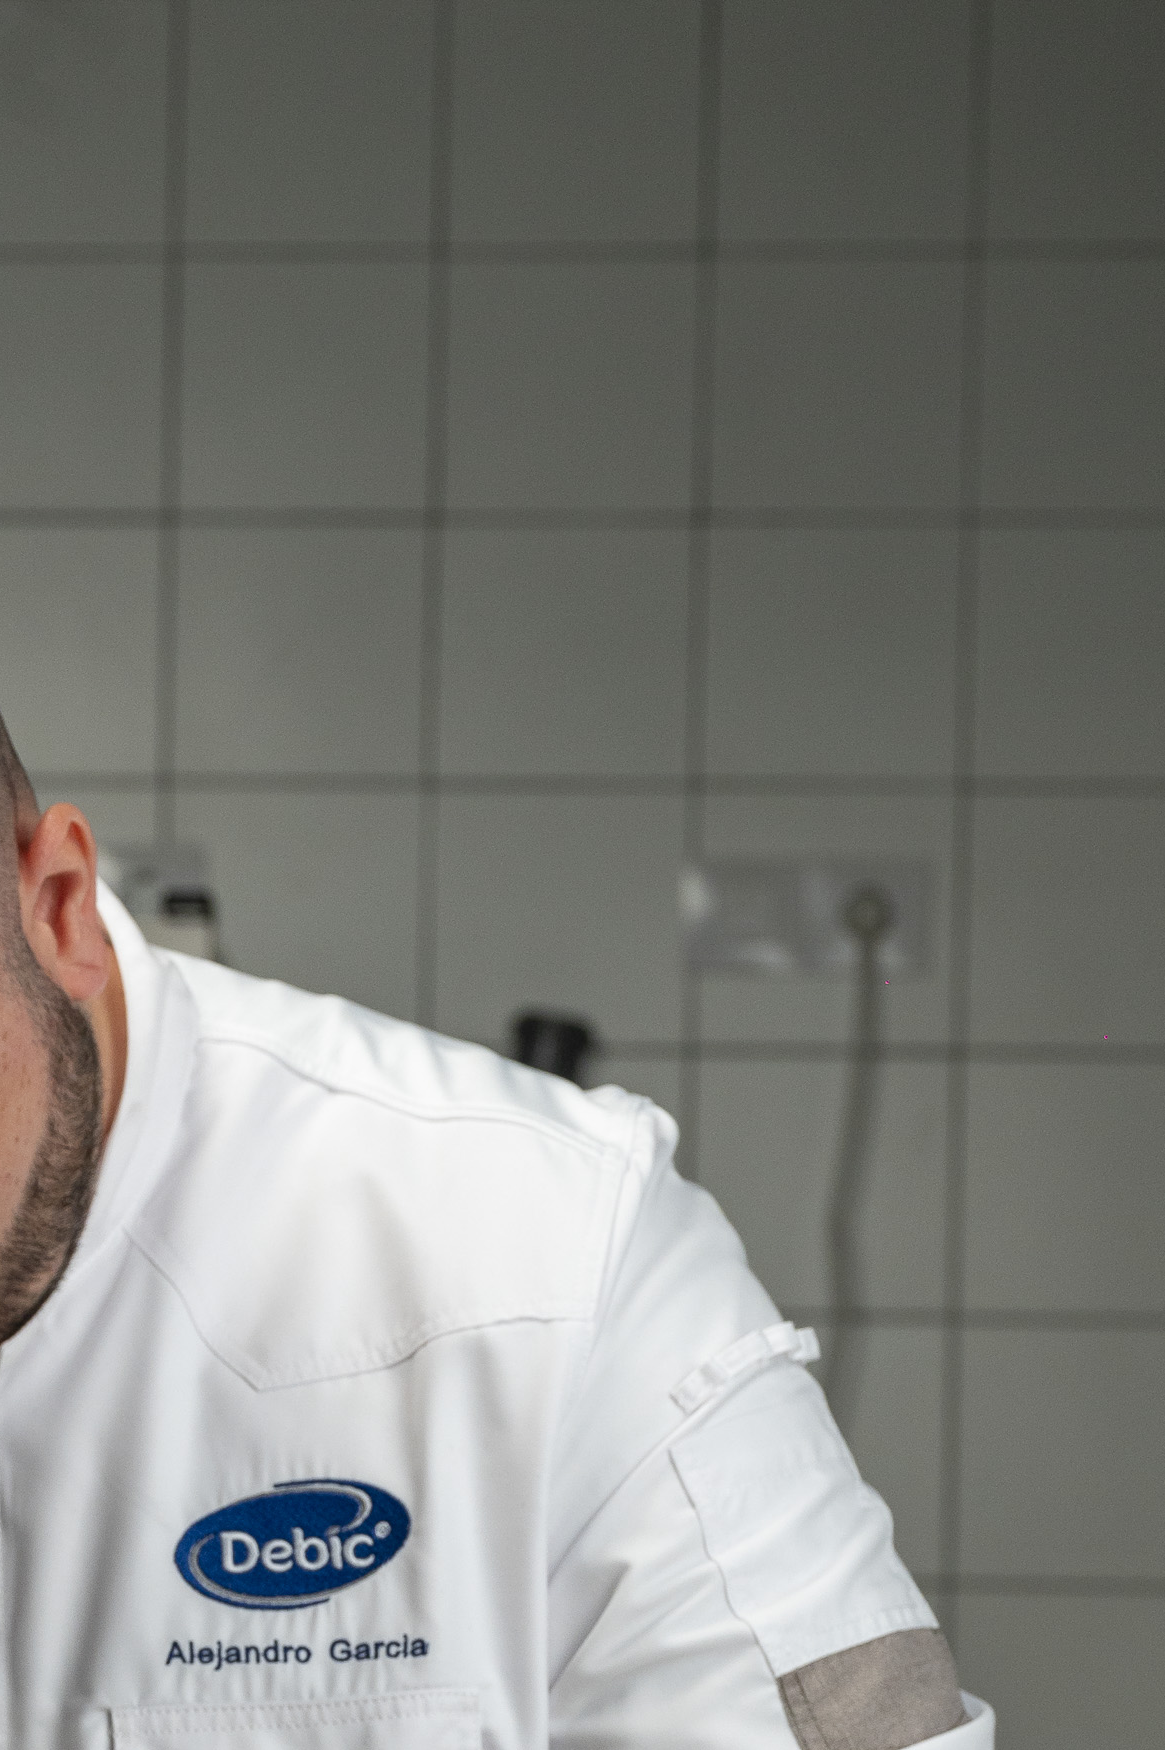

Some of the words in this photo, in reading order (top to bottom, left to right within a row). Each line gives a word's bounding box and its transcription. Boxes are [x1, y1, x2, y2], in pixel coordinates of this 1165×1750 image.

[219, 1525, 376, 1575] Debic
[165, 1639, 312, 1672] Alejandro
[329, 1633, 429, 1662] Garcia
